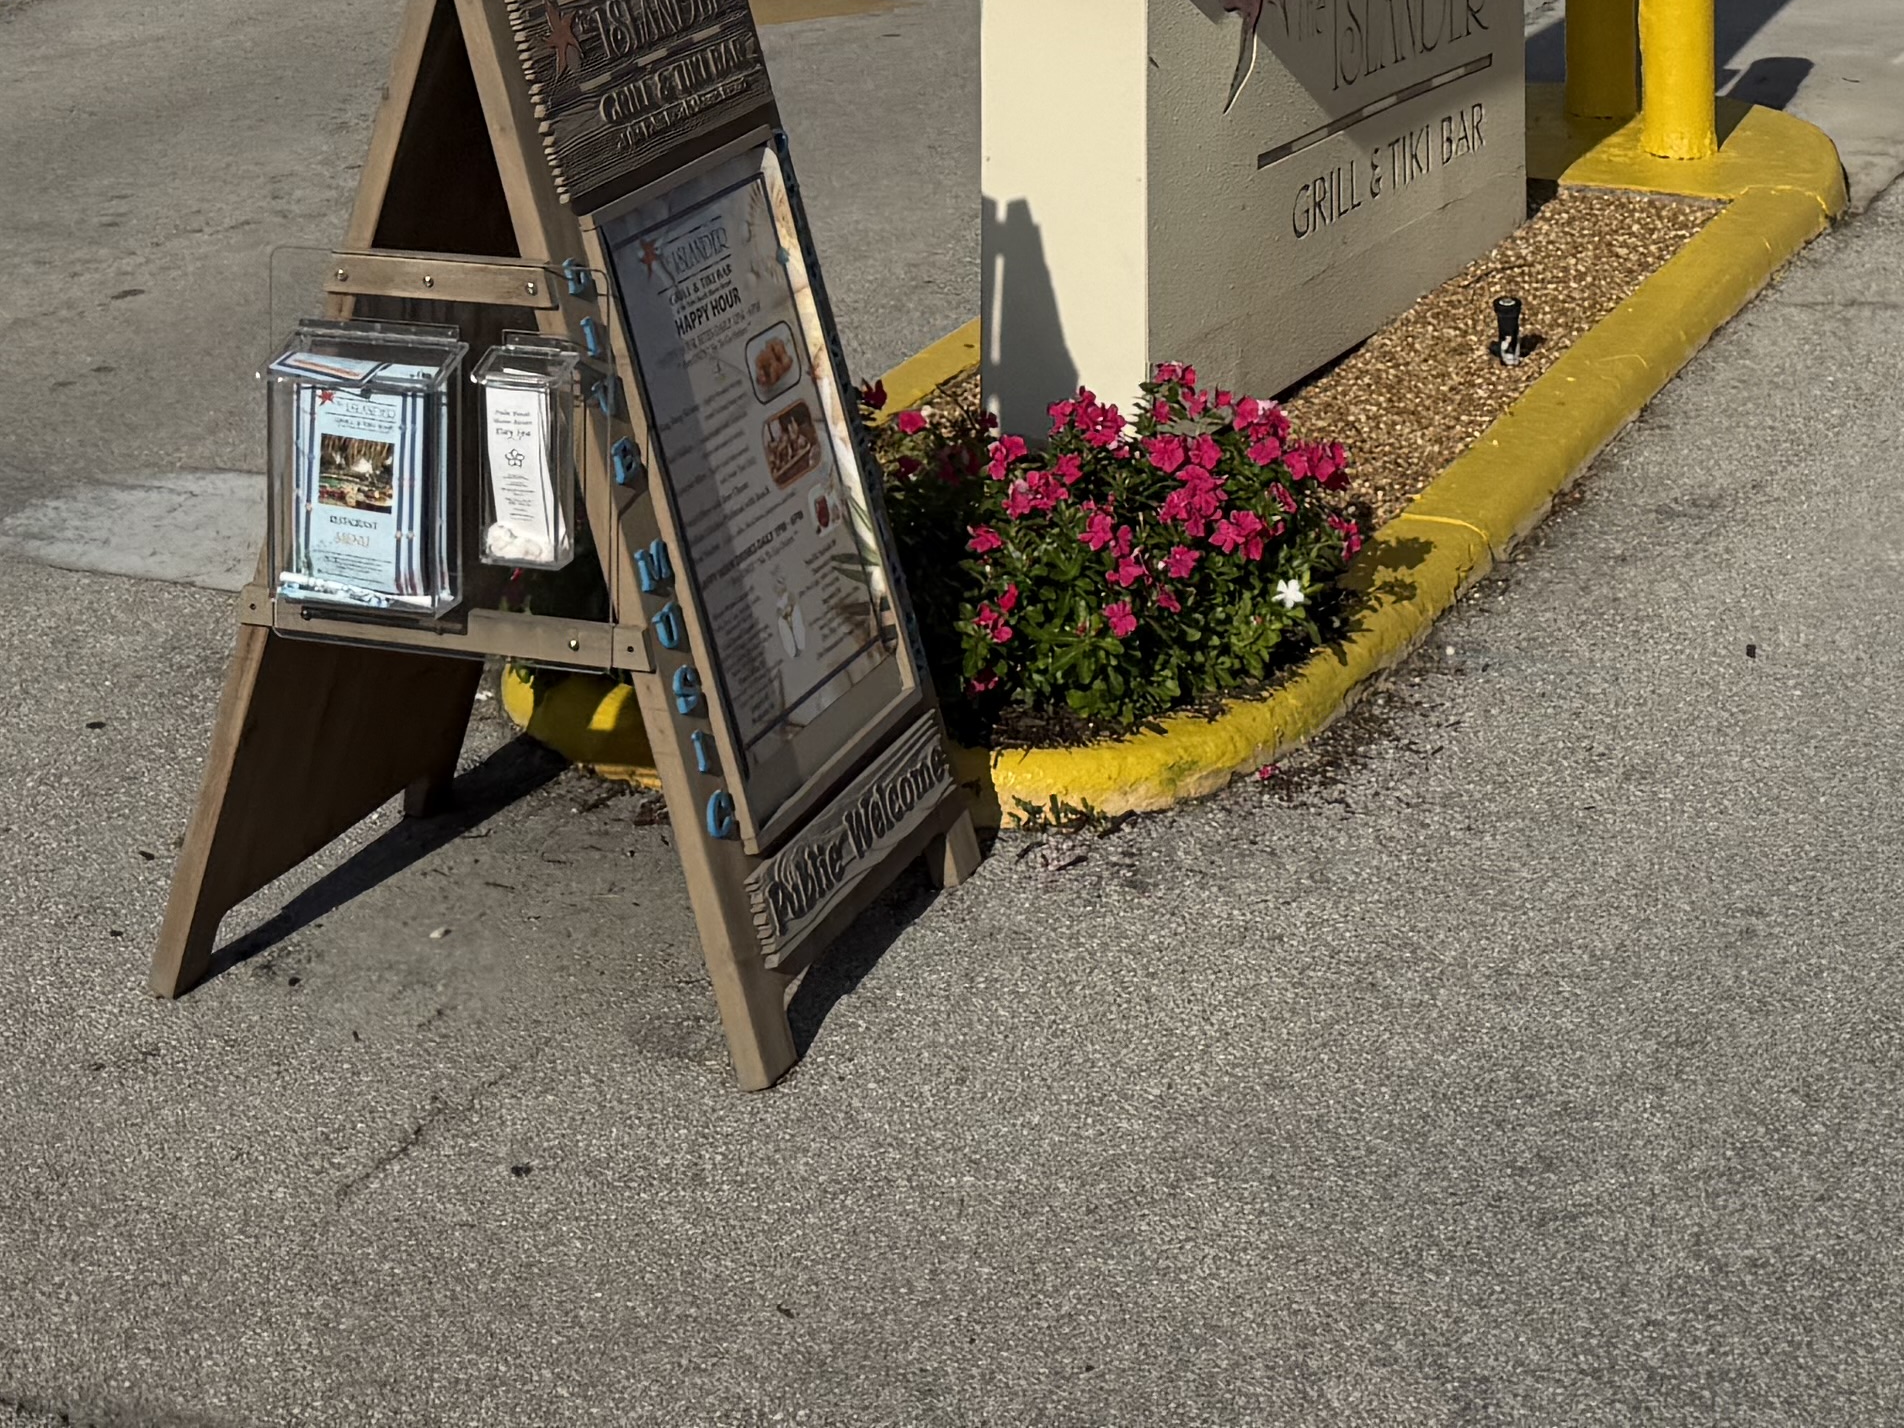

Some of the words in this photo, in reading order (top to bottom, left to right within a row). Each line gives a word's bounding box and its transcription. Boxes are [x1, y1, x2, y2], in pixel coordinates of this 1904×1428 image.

[1292, 159, 1361, 239] GRILL
[1369, 147, 1383, 199] &
[1388, 123, 1431, 190] TIKI
[1440, 103, 1486, 168] BAR
[669, 227, 730, 276] ISLANDER
[674, 305, 710, 337] HAPPY
[711, 286, 742, 318] HOUR
[634, 537, 733, 840] MUSIC
[765, 836, 849, 938] Public
[842, 744, 951, 860] Welcome
